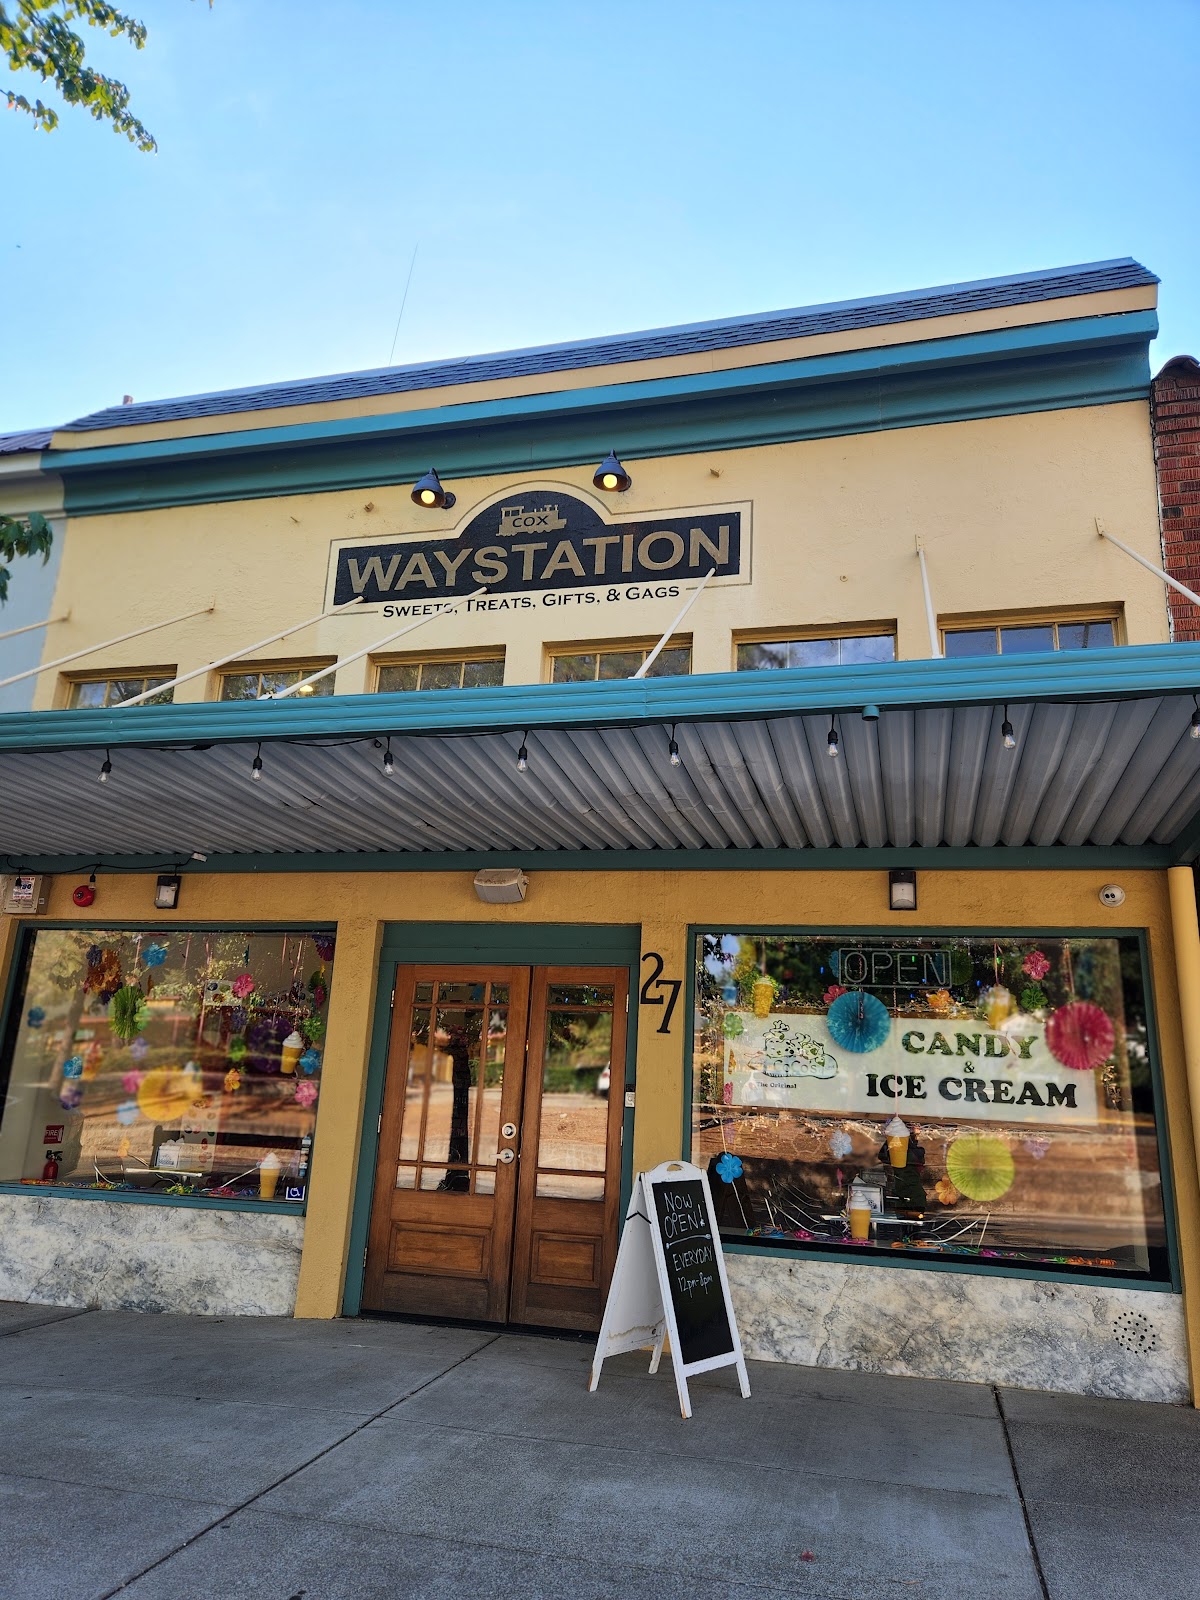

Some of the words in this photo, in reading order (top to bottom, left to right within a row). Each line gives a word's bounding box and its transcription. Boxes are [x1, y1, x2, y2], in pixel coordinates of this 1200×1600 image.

[512, 515, 549, 528] COX
[347, 525, 730, 594] WAYSTATION
[542, 592, 601, 607] GIFTS,
[606, 588, 621, 602] &
[625, 585, 680, 600] GAGS
[844, 951, 946, 986] OPEN
[640, 952, 682, 1034] 27
[901, 1030, 1038, 1059] CANDY
[963, 1060, 975, 1075] &
[866, 1073, 928, 1099] ICE
[938, 1076, 1078, 1108] CREAM
[664, 1191, 693, 1213] NOW
[664, 1203, 706, 1239] OPEN!
[672, 1245, 713, 1272] EVERYDAY
